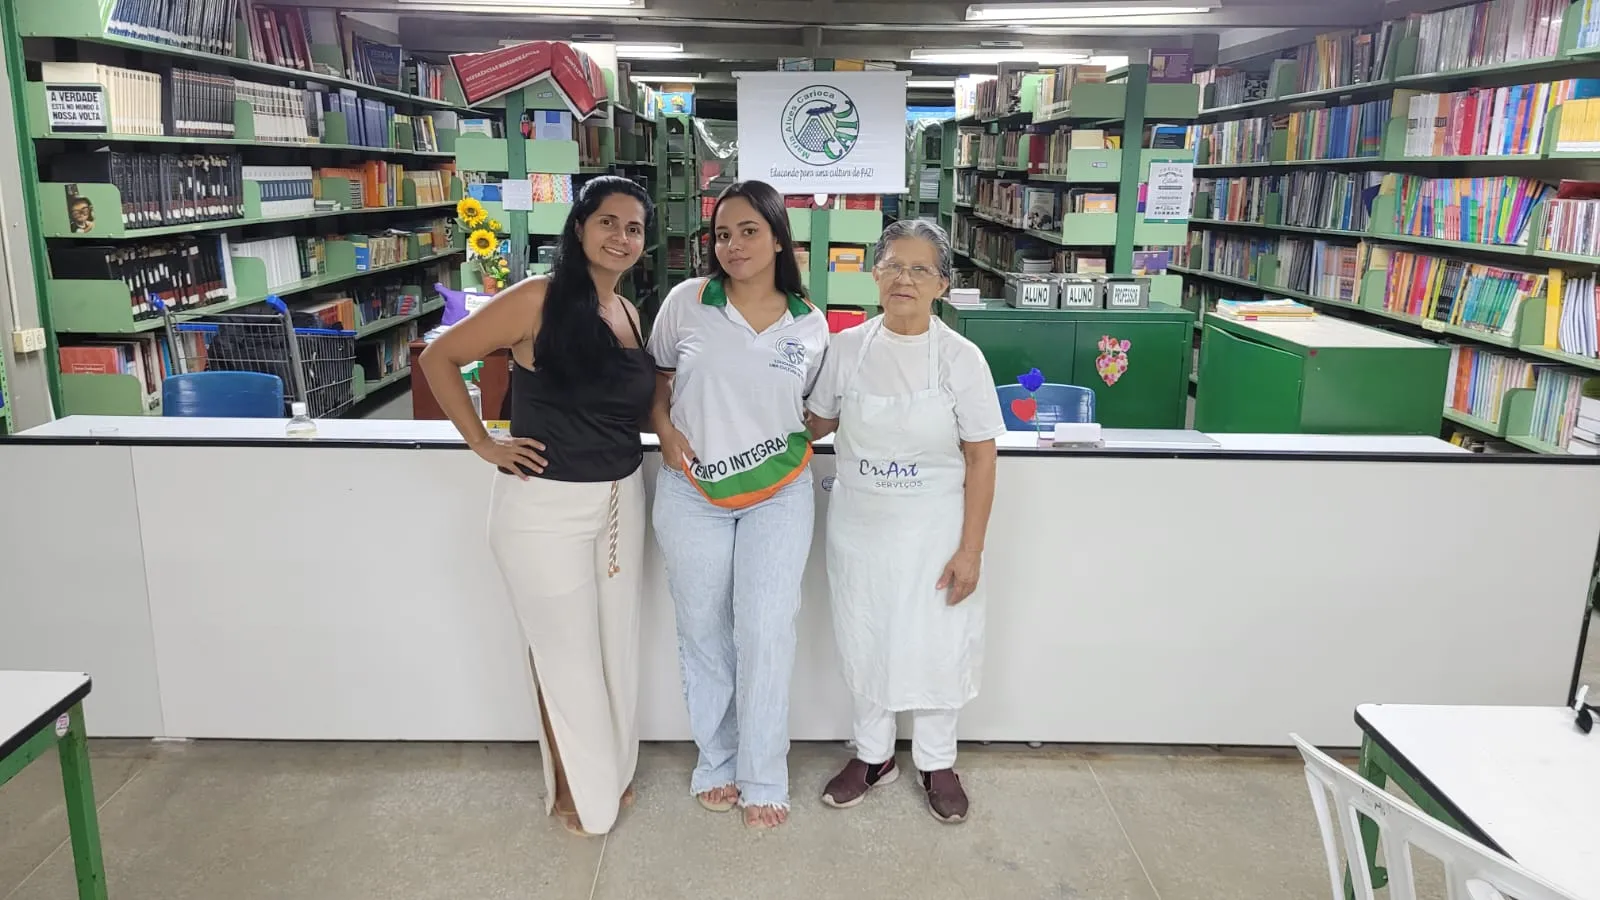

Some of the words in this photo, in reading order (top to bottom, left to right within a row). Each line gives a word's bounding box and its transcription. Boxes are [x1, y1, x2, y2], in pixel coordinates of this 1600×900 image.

[51, 91, 57, 102] A
[59, 92, 99, 103] VERDADE
[52, 111, 78, 120] NOSSA
[78, 112, 101, 121] VOLTA
[785, 105, 797, 133] Alves
[796, 89, 836, 104] Carioca
[769, 167, 800, 178] Educando
[799, 169, 814, 181] para
[815, 169, 829, 178] uma
[829, 167, 851, 178] cultura
[851, 167, 860, 178] de
[1024, 287, 1048, 302] ALUNO
[1069, 287, 1093, 302] ALUNO
[859, 458, 919, 479] CriArt
[874, 480, 923, 489] SERVIÇOS
